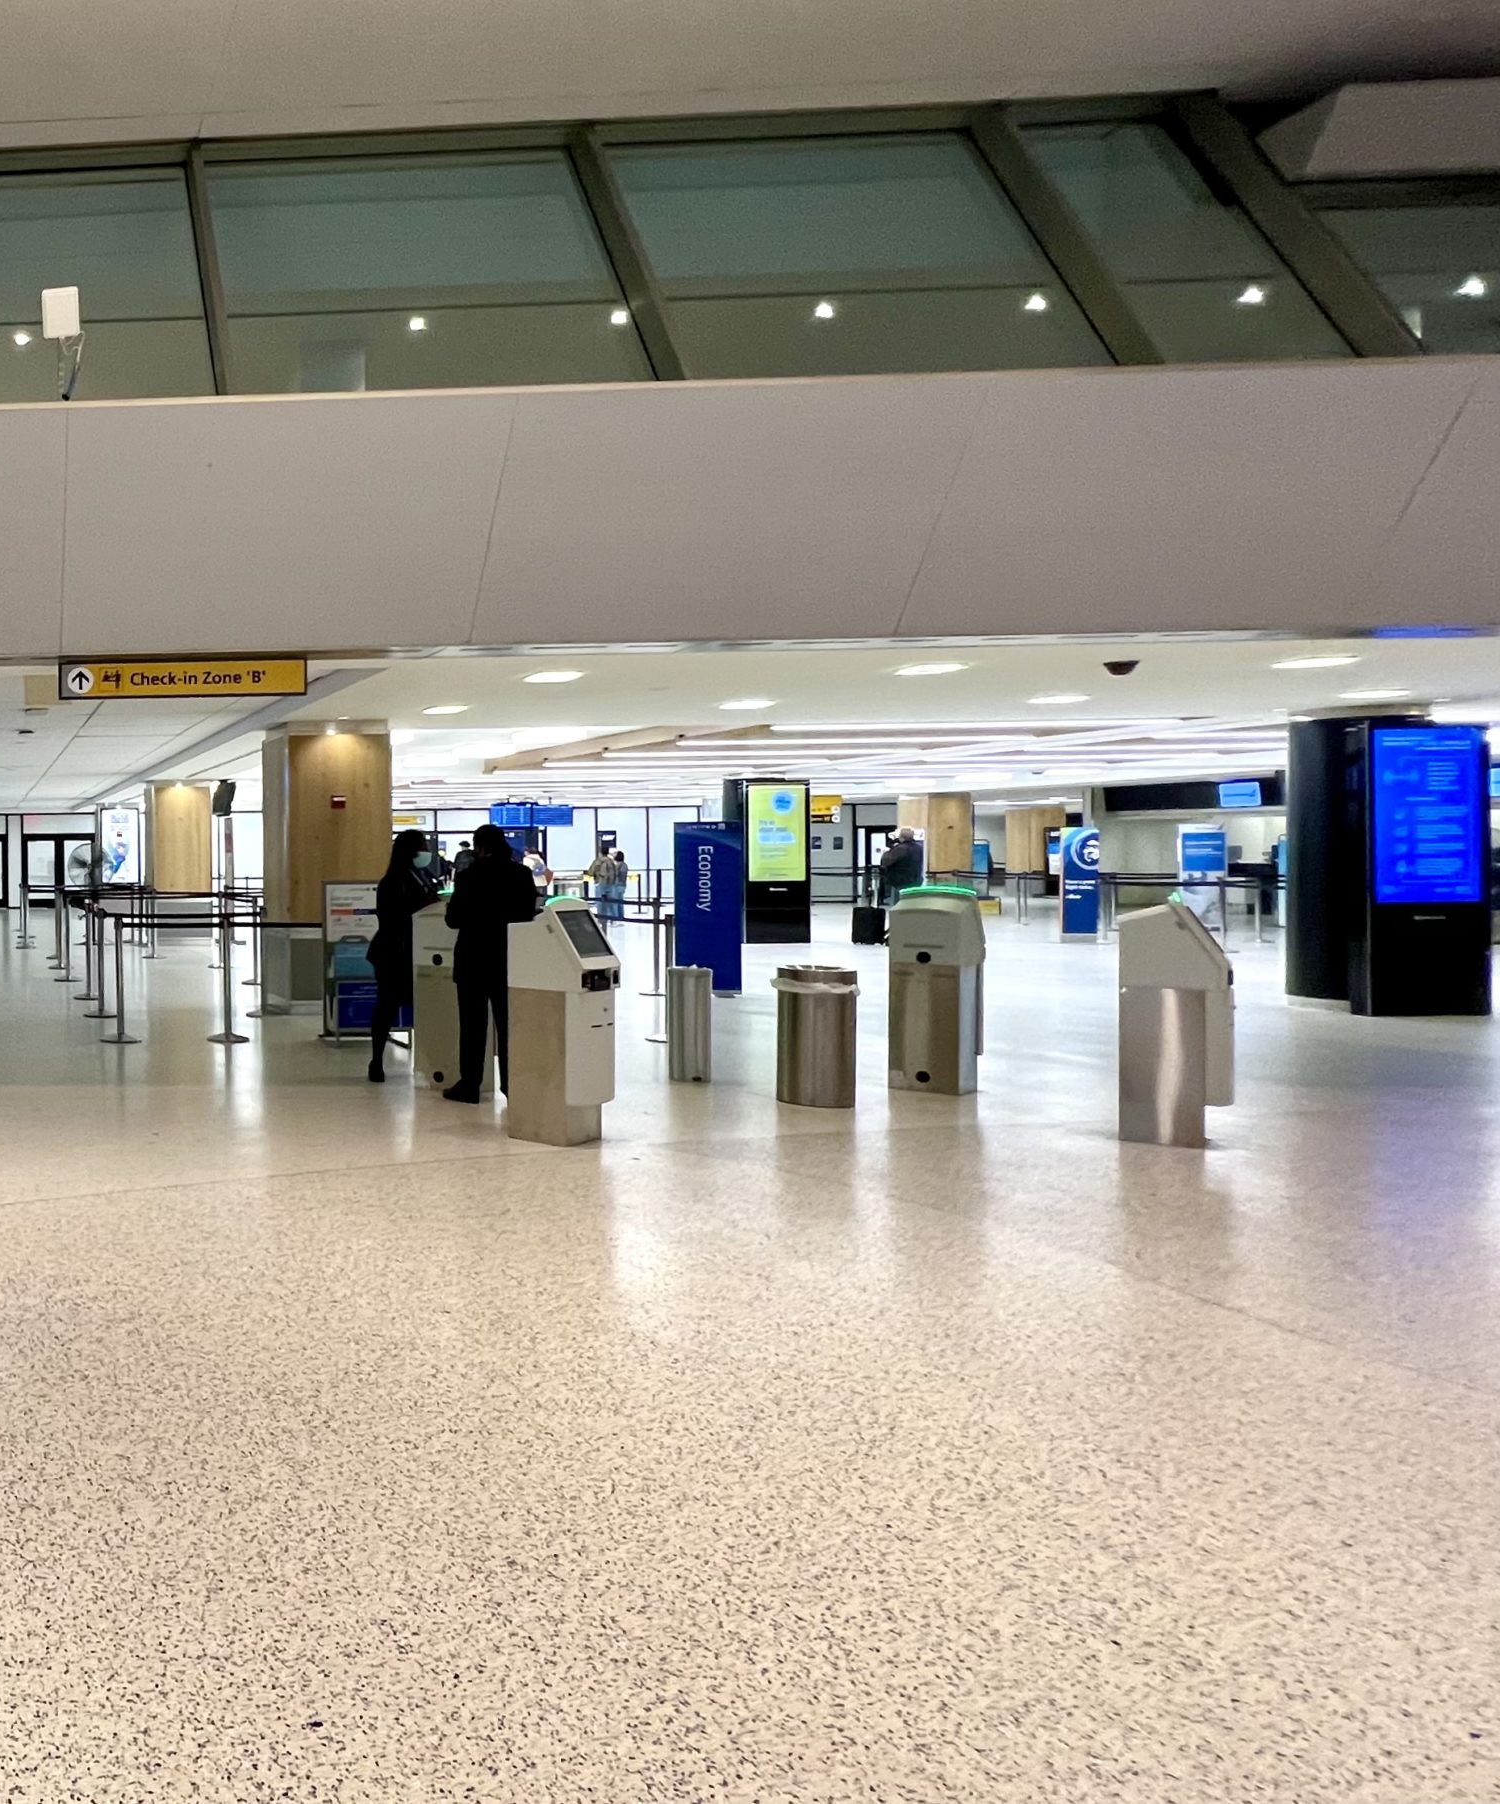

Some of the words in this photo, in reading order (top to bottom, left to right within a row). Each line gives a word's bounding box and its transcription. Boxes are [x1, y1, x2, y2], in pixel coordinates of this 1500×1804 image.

[130, 671, 198, 686] Check-in
[202, 670, 242, 685] Zone
[696, 845, 714, 912] Economy
